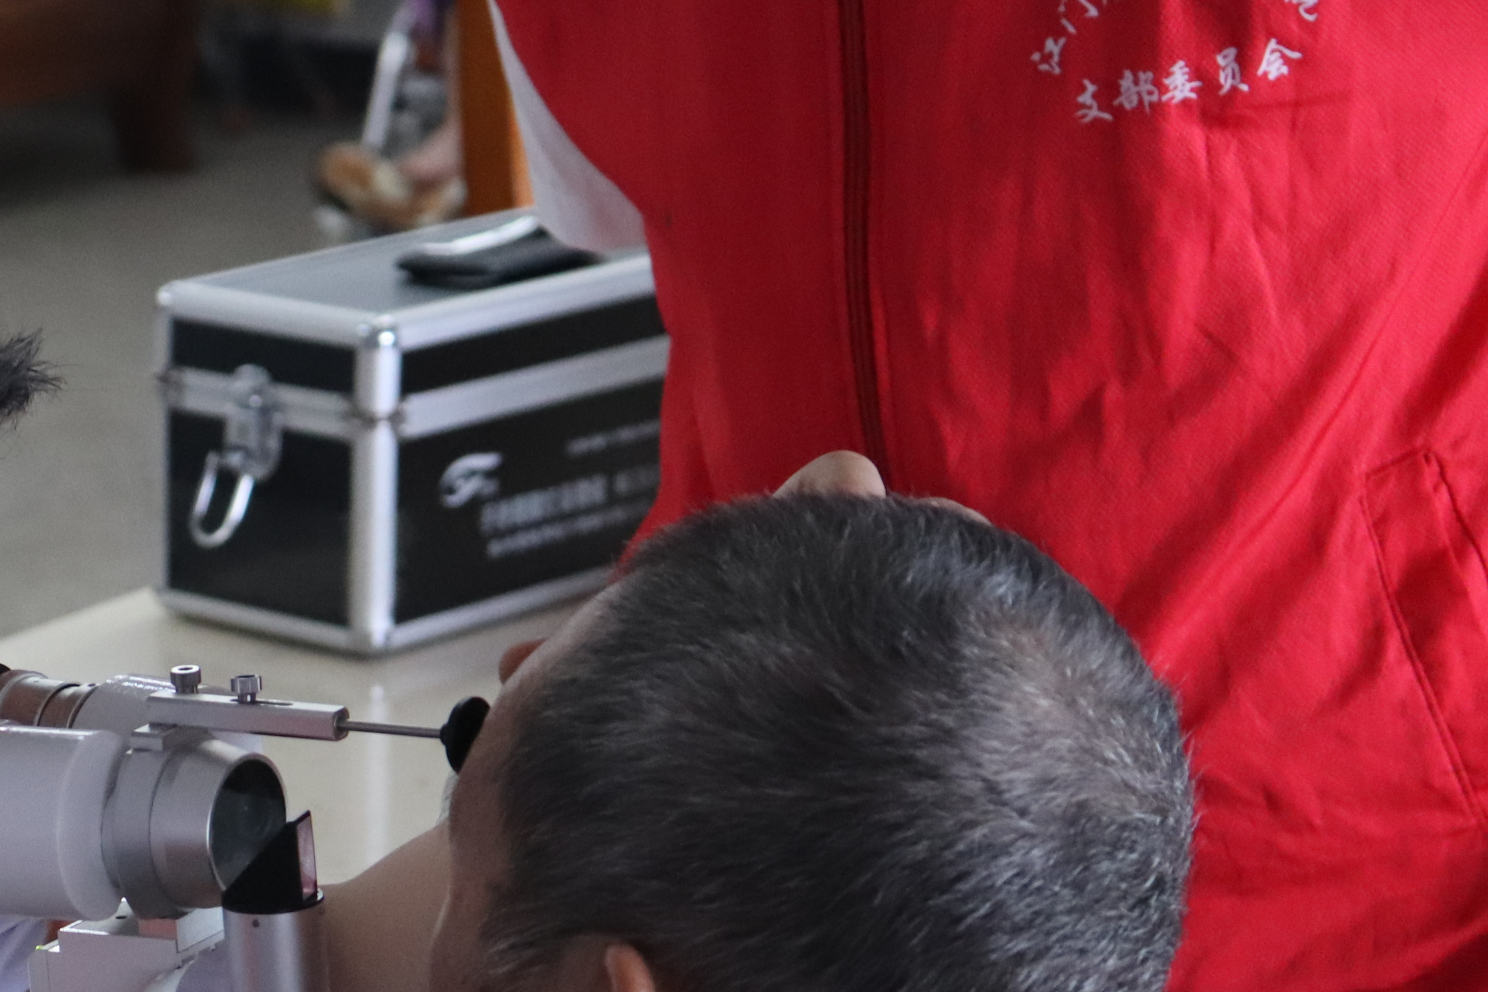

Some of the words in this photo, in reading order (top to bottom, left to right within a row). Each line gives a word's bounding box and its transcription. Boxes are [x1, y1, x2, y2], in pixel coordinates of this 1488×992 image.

[1076, 38, 1303, 123] 支部委员会
